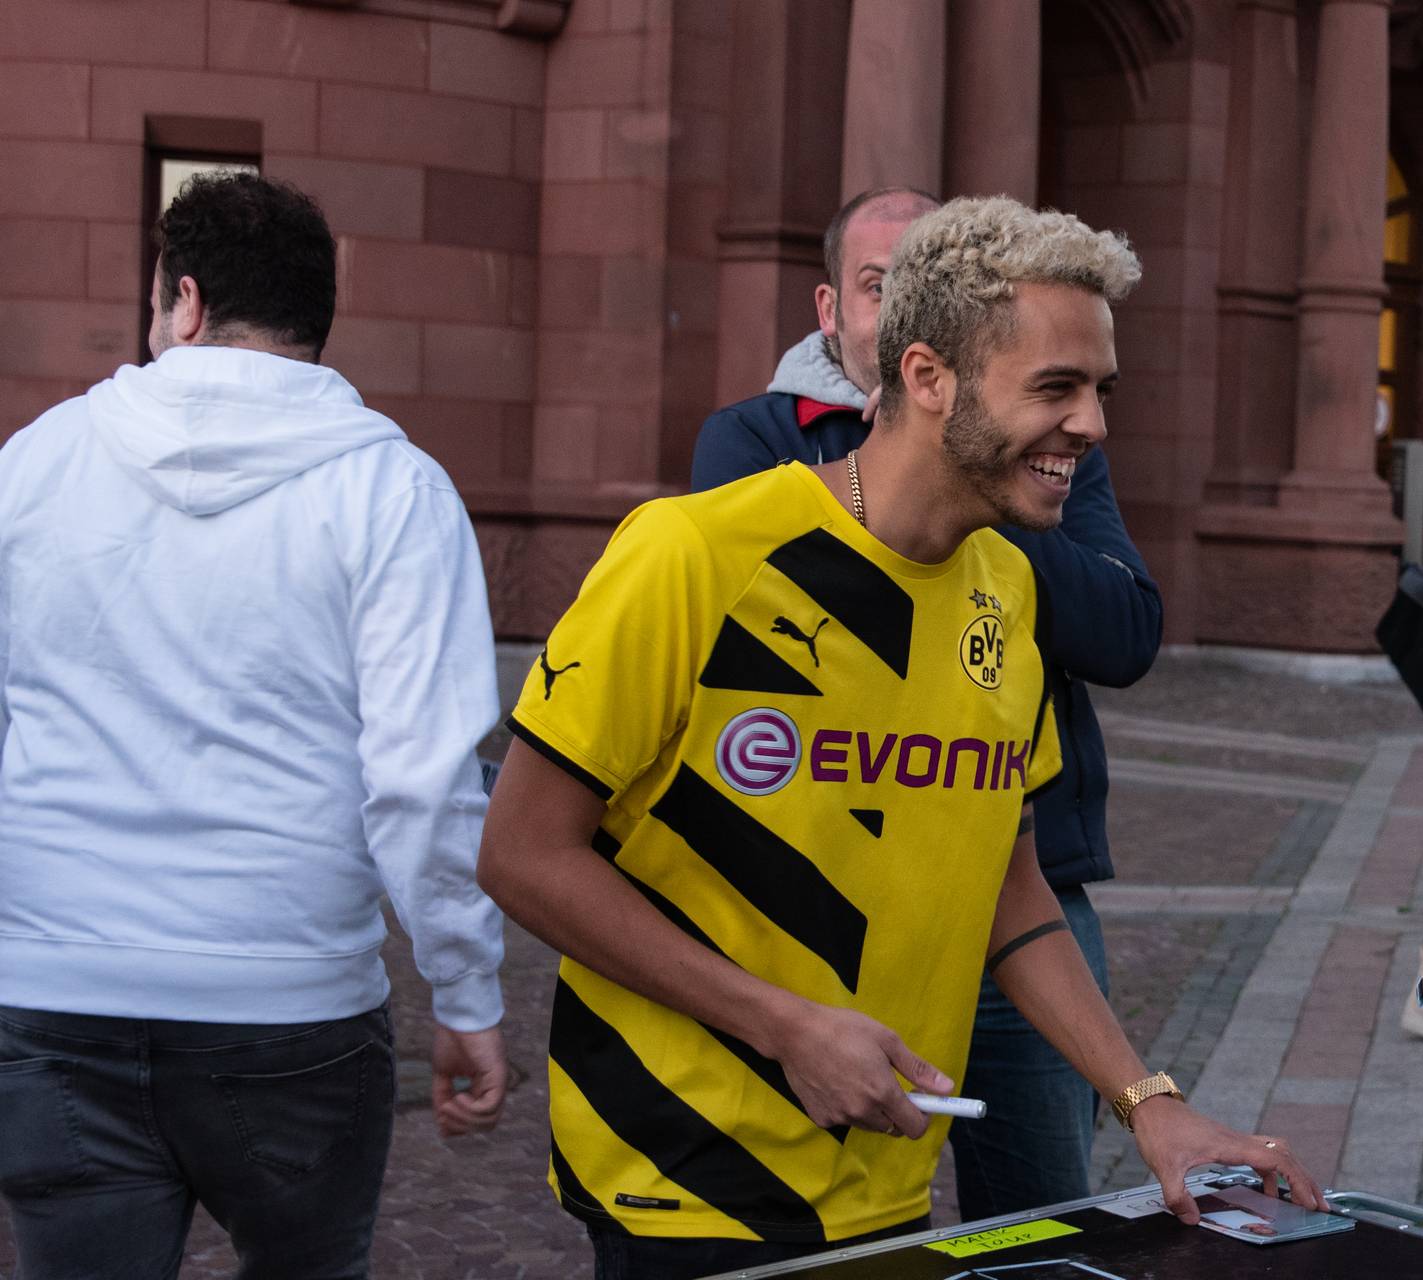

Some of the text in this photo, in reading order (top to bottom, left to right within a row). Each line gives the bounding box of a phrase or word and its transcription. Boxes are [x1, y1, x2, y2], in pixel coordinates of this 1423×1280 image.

[969, 621, 1003, 669] BVB
[982, 667, 996, 683] 09
[810, 729, 1030, 791] EVONIK
